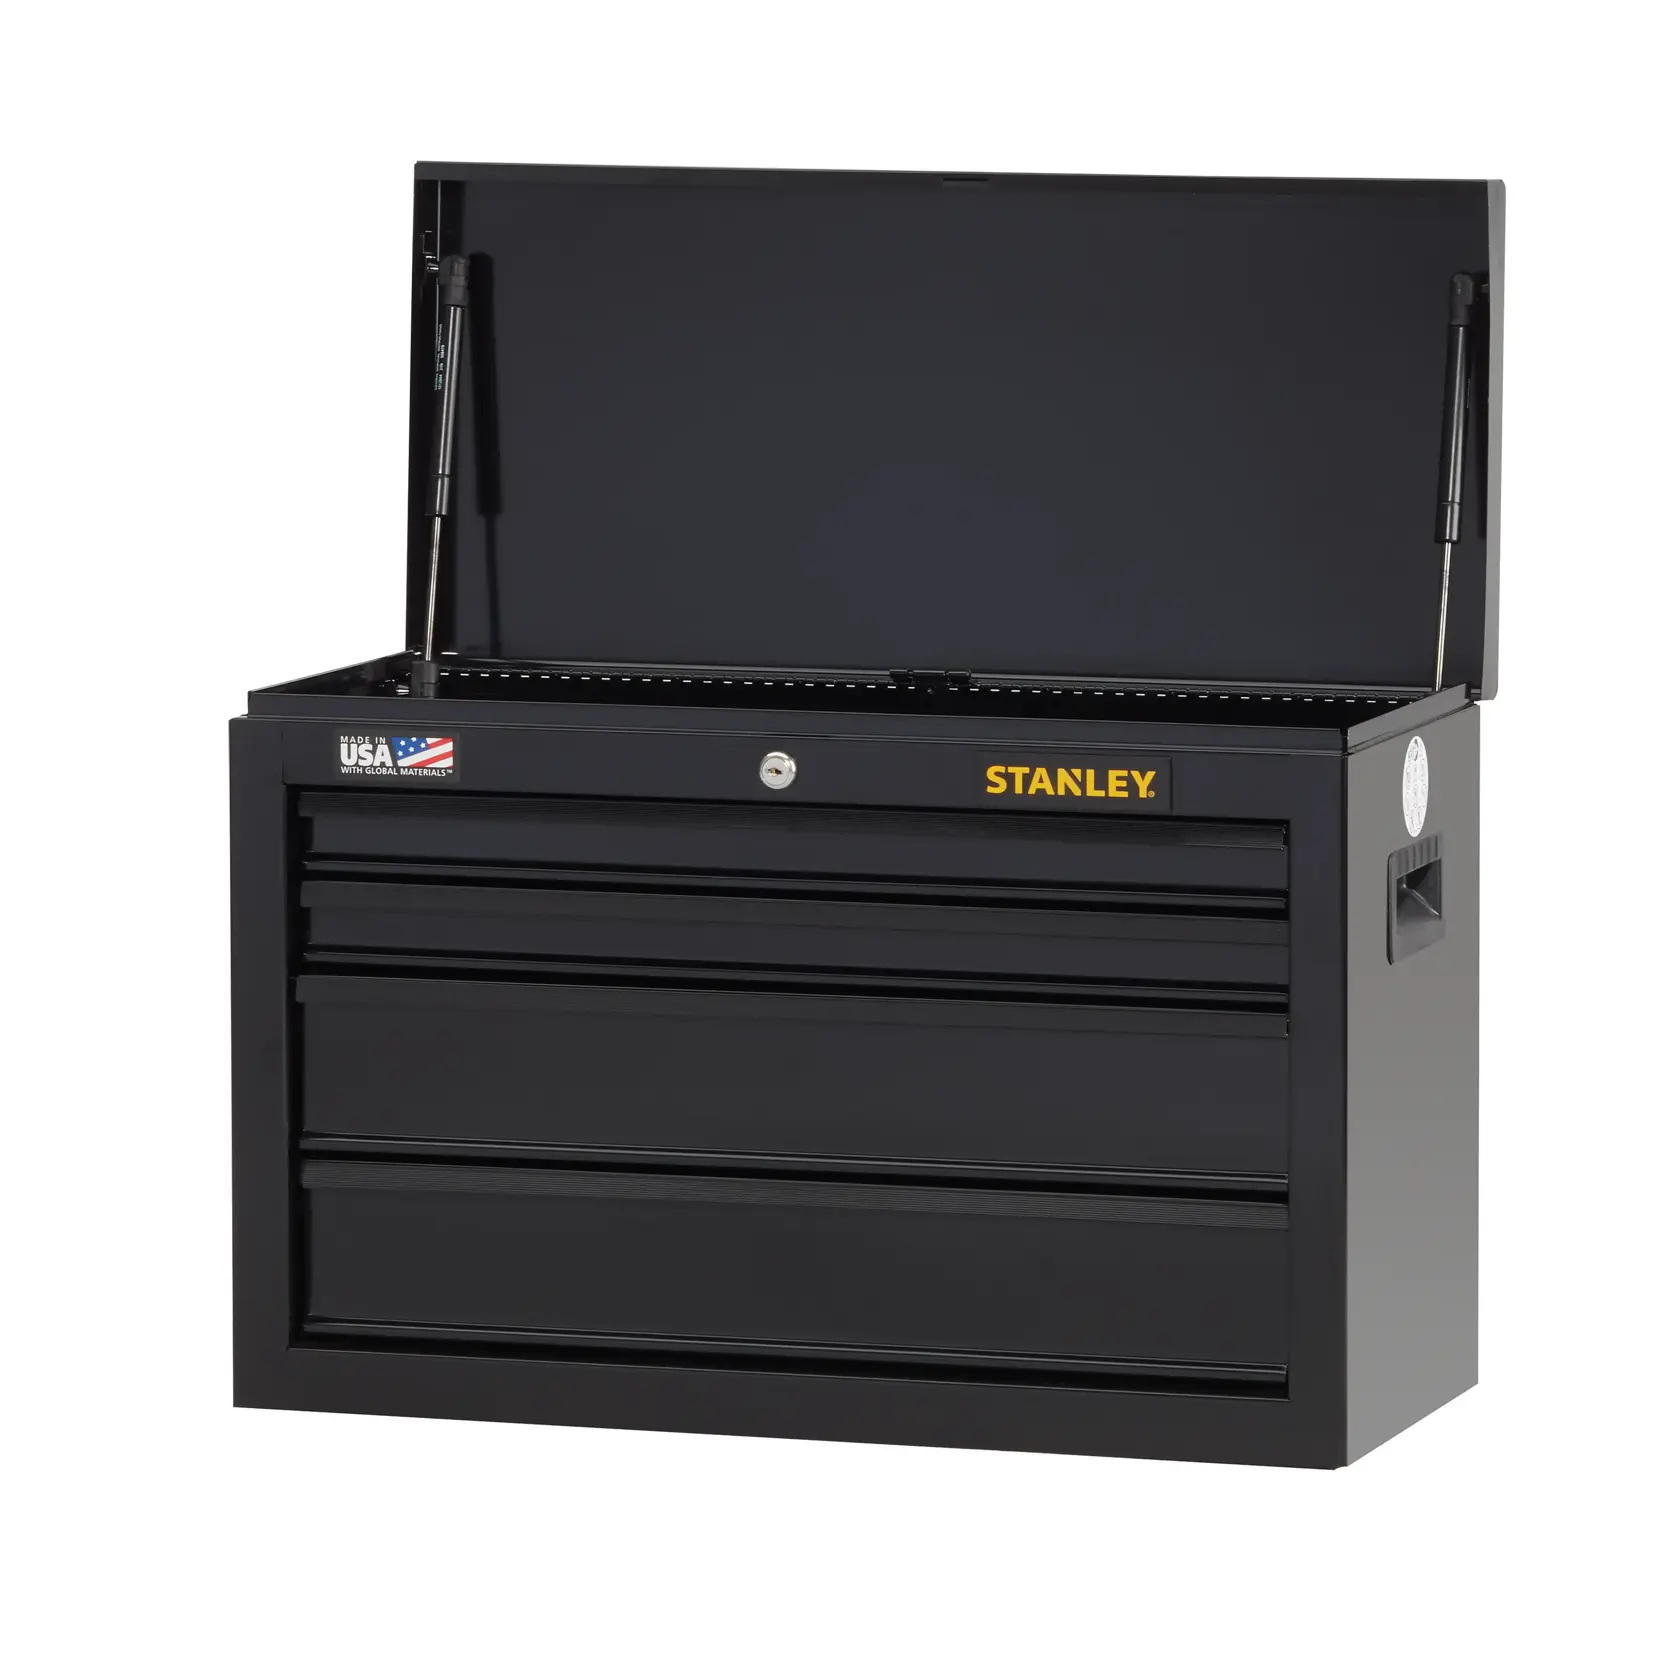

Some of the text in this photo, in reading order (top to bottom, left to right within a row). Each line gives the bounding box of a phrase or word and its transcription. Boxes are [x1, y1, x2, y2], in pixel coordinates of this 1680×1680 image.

[340, 736, 386, 745] MADE IN
[340, 743, 393, 767] USA
[340, 766, 363, 774] WITH
[365, 766, 398, 775] GLOBAL
